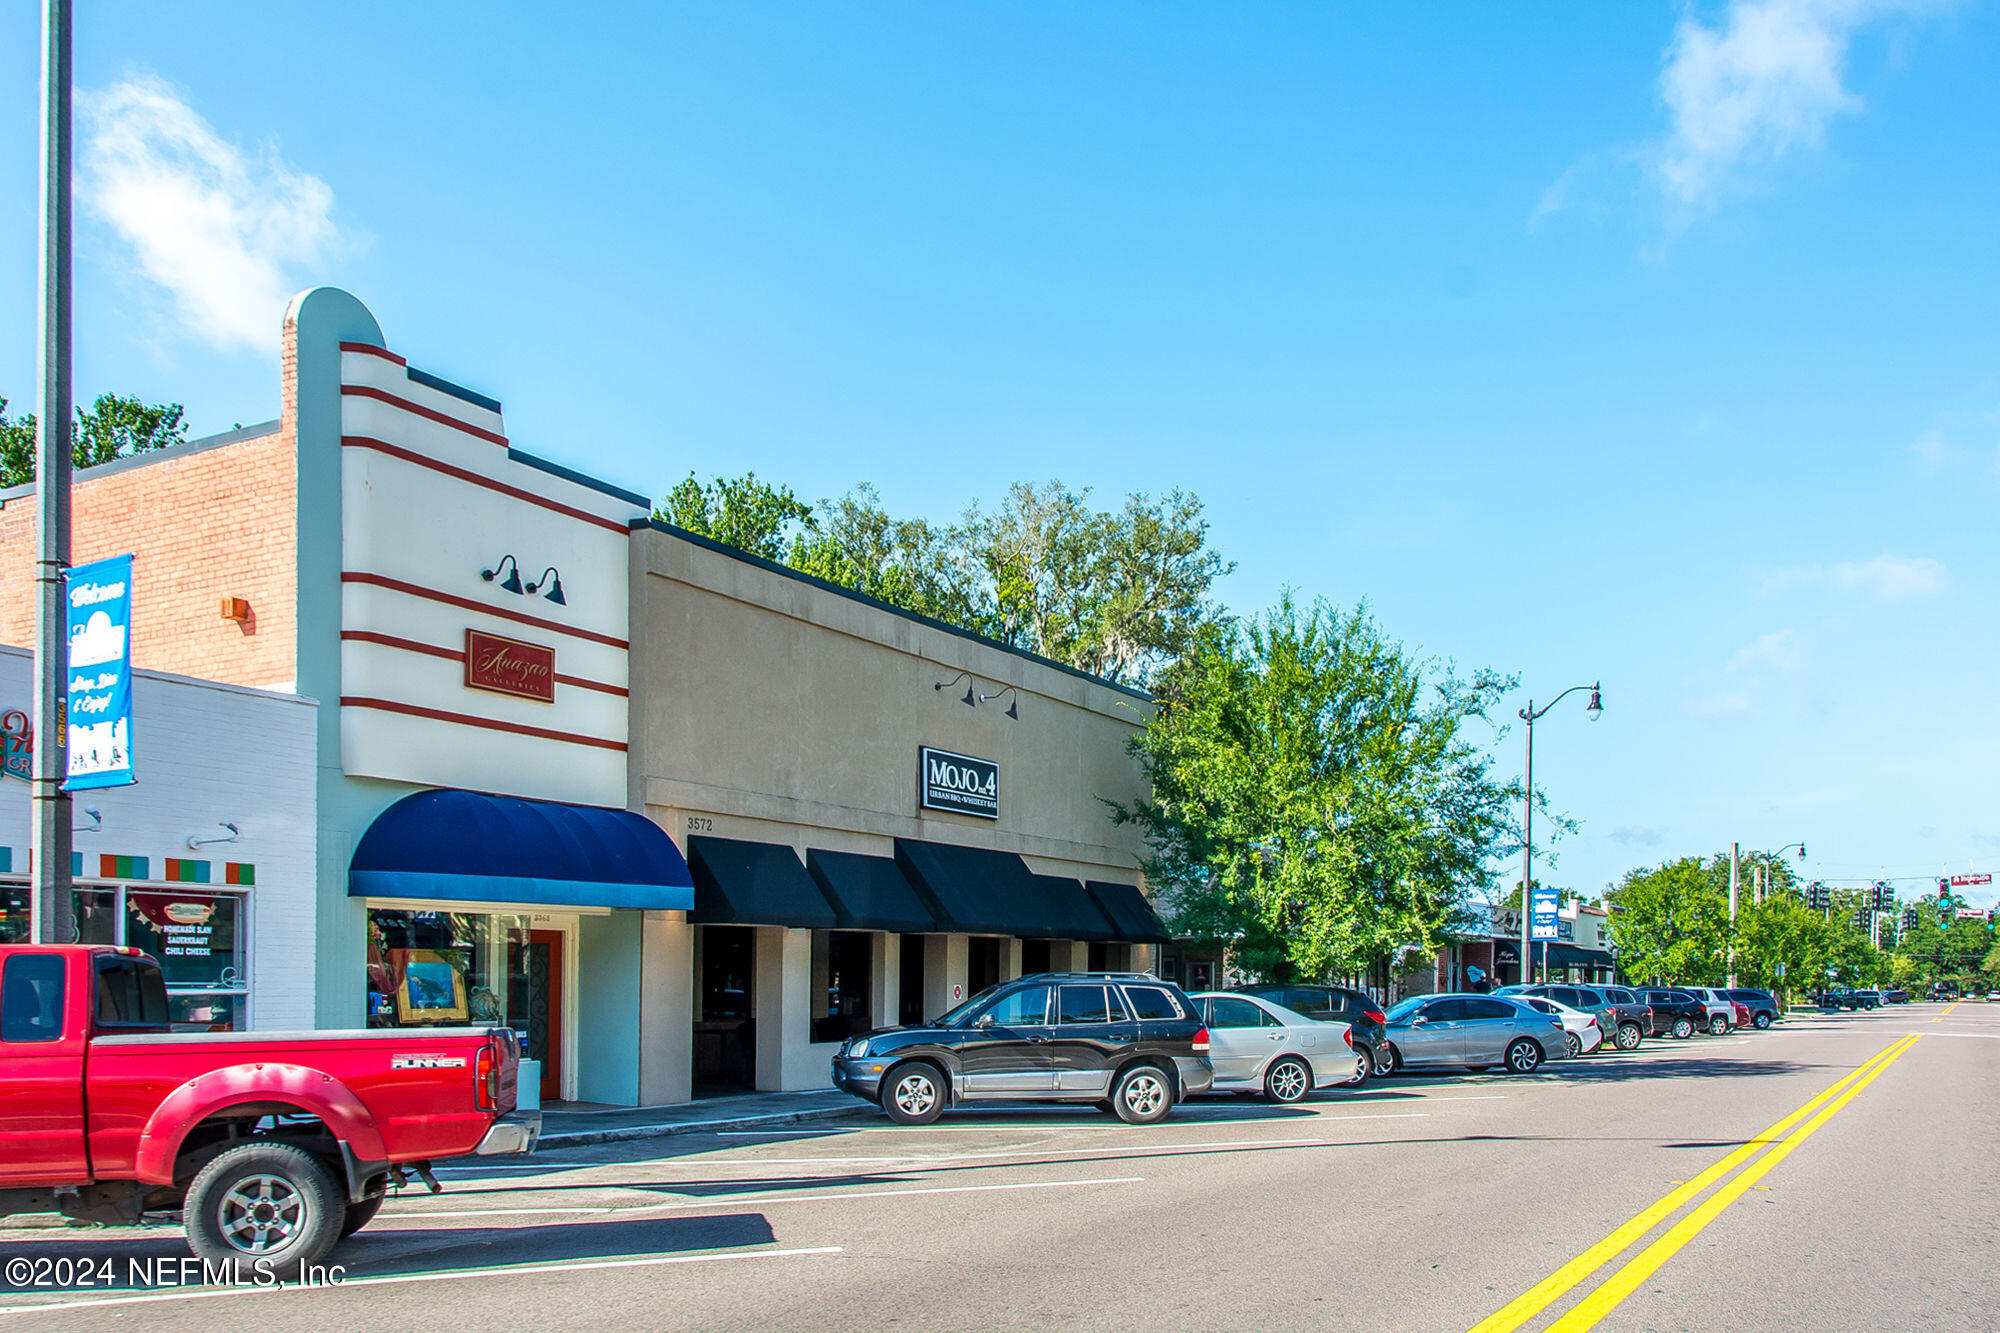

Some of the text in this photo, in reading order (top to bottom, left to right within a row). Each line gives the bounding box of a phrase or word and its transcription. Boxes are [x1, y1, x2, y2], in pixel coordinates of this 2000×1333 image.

[476, 647, 549, 681] Anazao
[929, 758, 979, 792] MOJO
[985, 771, 996, 796] 4
[687, 817, 713, 831] 3572
[163, 925, 213, 934] HOMEMADE SLAW
[167, 936, 208, 945] SAUERKRAUT
[165, 947, 211, 956] CHILI CHEESE
[392, 1058, 467, 1070] RUNNER
